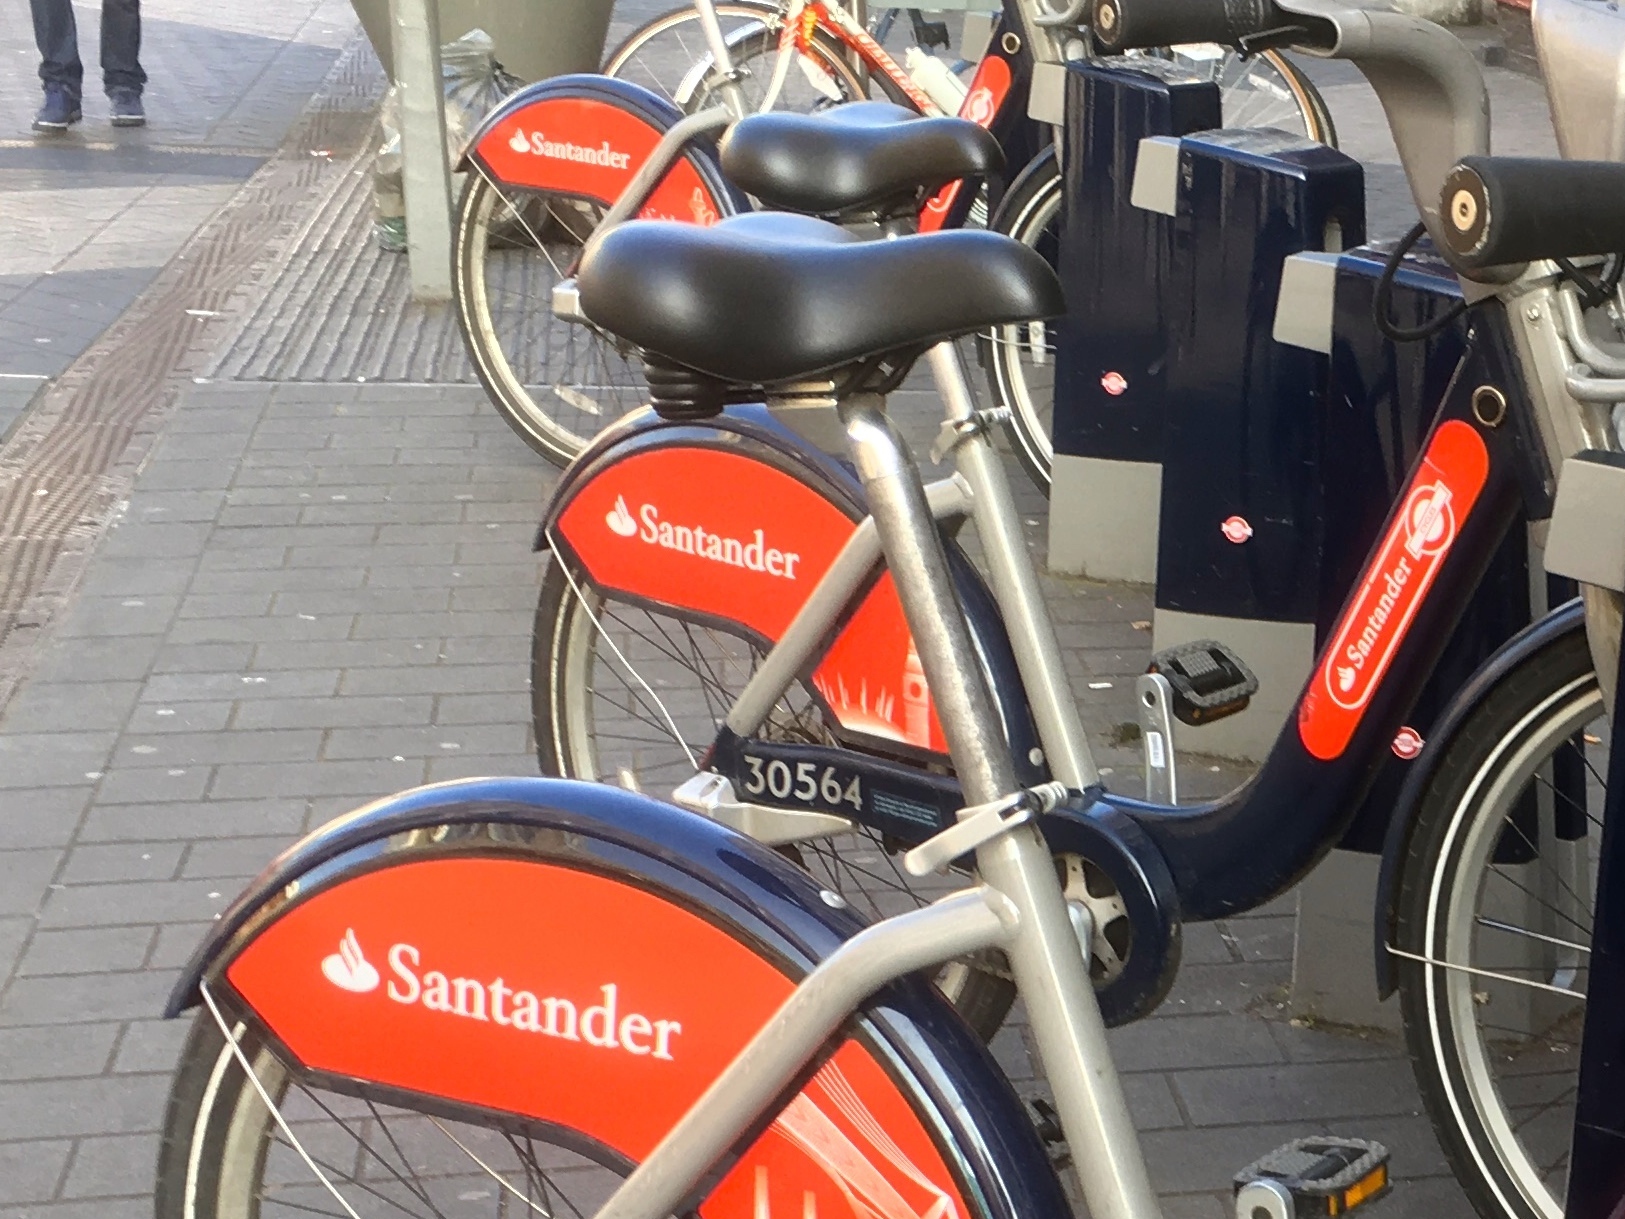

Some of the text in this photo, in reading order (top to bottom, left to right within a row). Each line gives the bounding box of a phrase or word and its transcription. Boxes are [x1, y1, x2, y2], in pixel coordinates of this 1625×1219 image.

[531, 131, 631, 169] Santander
[640, 503, 799, 580] Santander
[1419, 507, 1437, 535] CYCLES
[1346, 556, 1413, 671] Santander
[744, 755, 863, 811] 30564
[387, 942, 682, 1061] Santander
